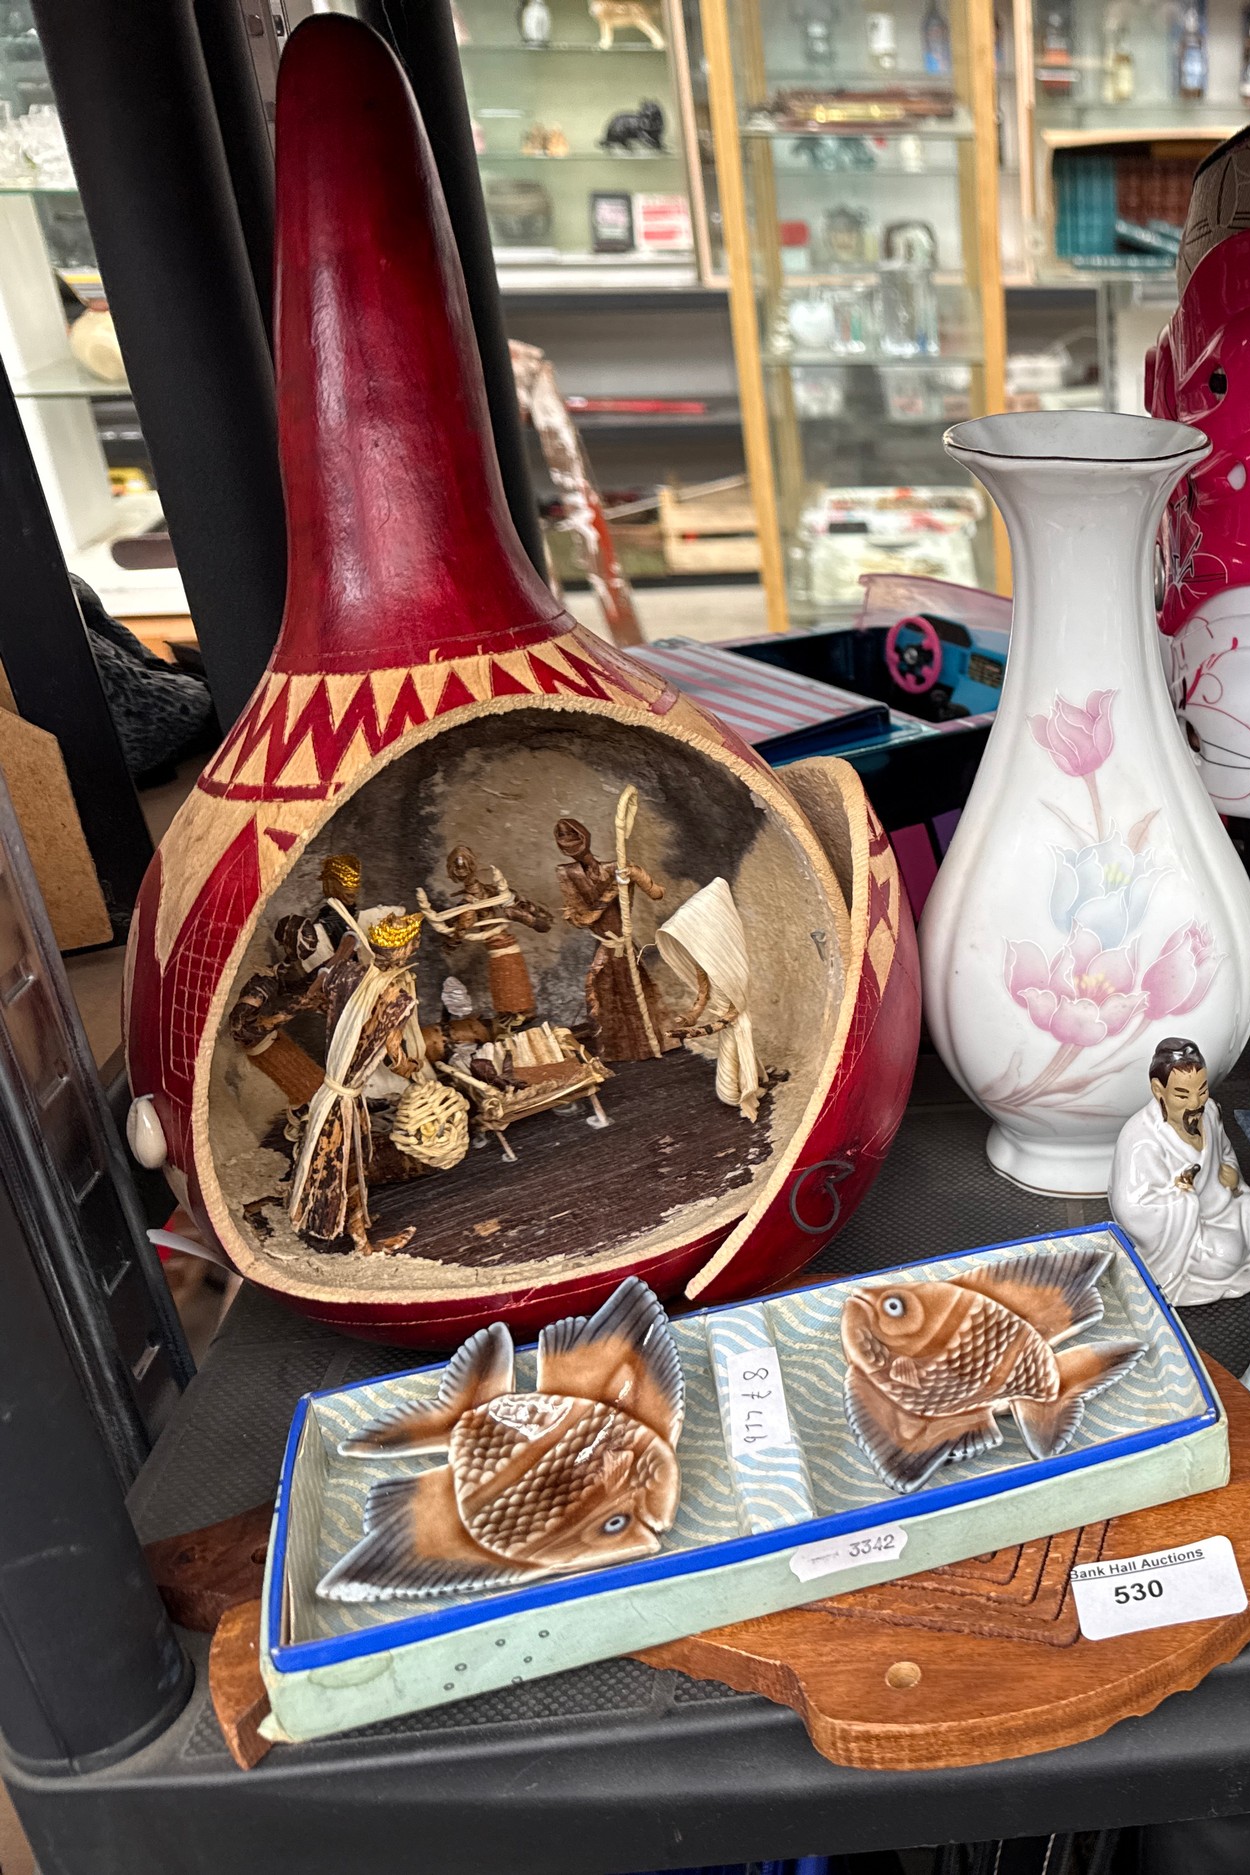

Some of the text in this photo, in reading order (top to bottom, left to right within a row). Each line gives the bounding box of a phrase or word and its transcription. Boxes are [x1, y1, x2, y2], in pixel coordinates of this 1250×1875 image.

[849, 1533, 896, 1557] 3342
[1069, 1548, 1204, 1580] Bank Hall Auctions
[1114, 1579, 1164, 1605] 530
